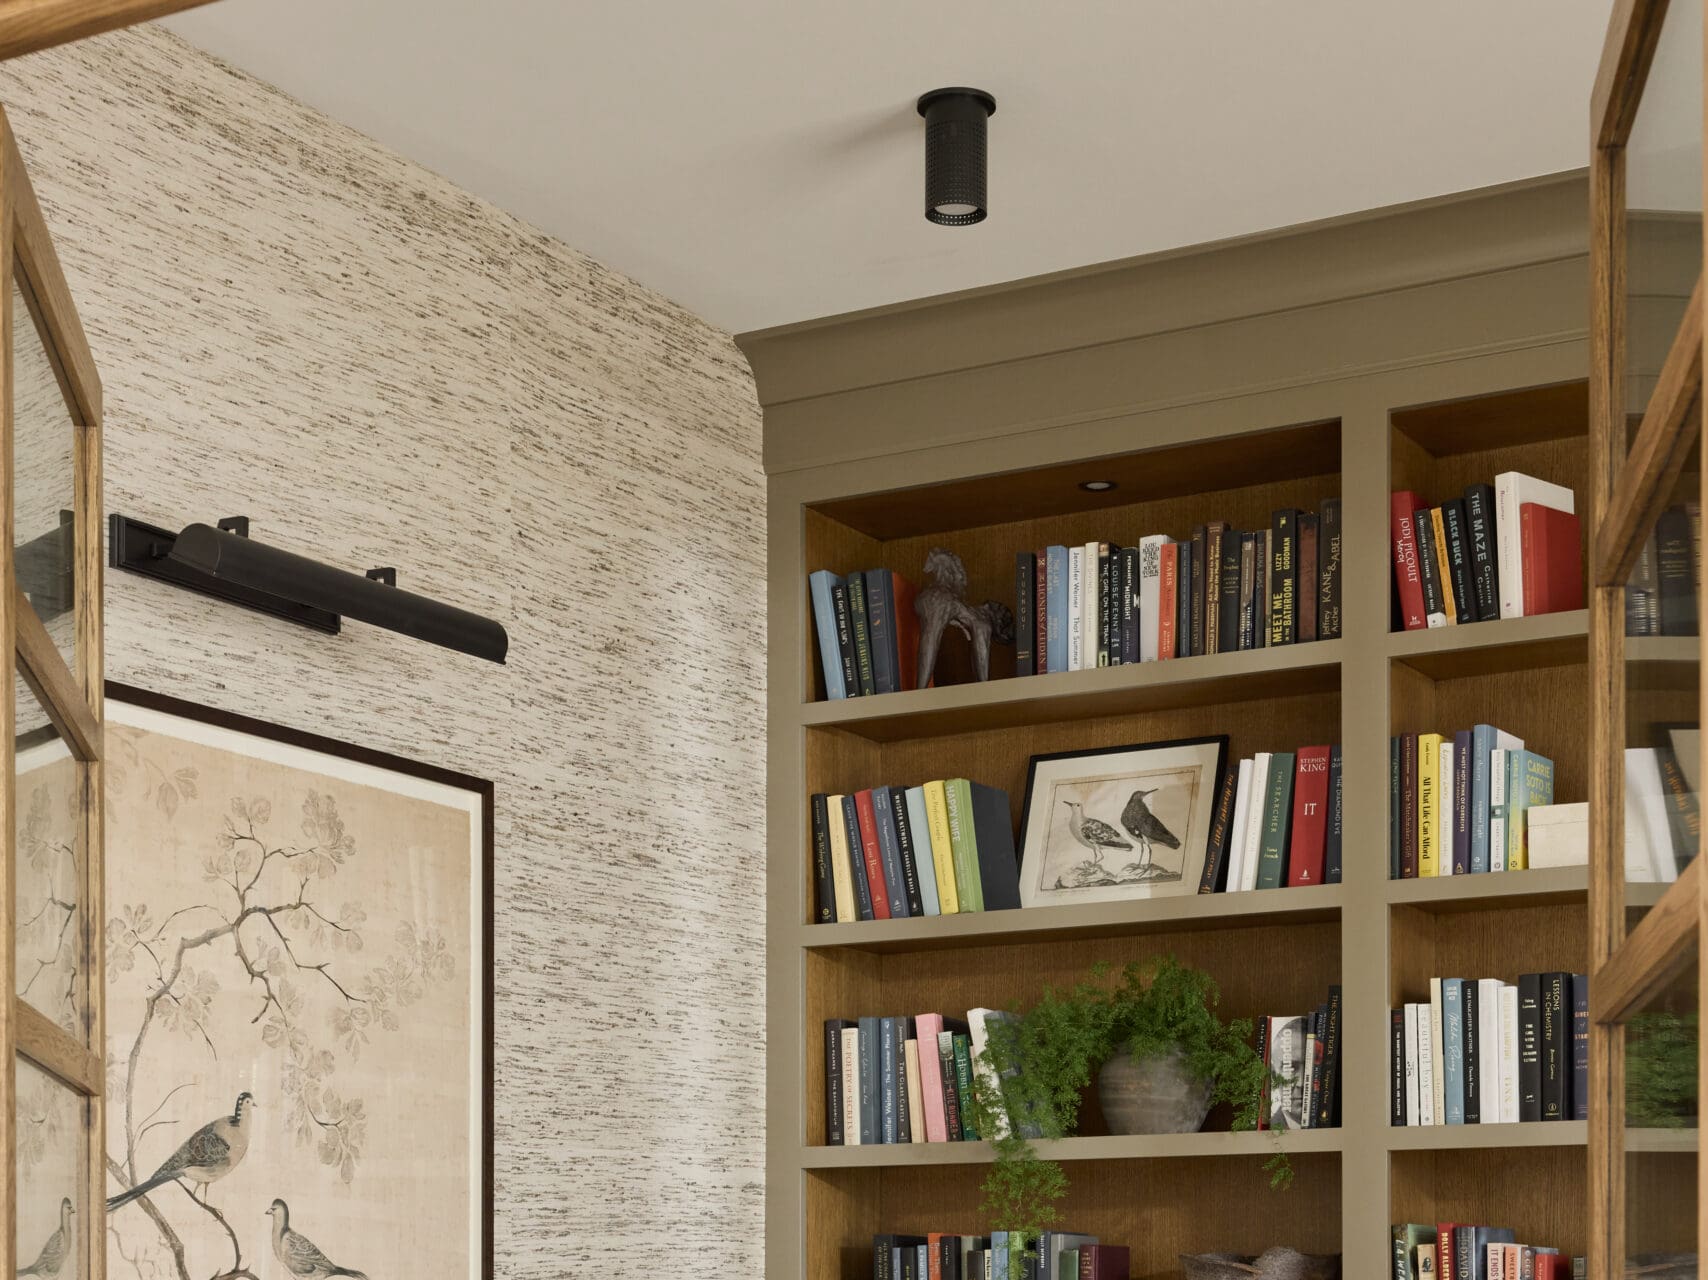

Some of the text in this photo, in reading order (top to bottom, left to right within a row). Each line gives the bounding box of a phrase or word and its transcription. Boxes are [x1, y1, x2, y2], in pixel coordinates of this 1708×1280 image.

[1448, 509, 1463, 566] BLACK BUCK
[1471, 493, 1487, 562] THE MAZE
[1399, 517, 1417, 583] JODI PICOULT
[1322, 571, 1331, 603] KANE
[1331, 533, 1340, 561] ABEL
[1273, 592, 1283, 642] MEET ME
[1283, 578, 1292, 626] BATHROOM
[1300, 763, 1326, 773] KING
[1528, 759, 1551, 778] CARRIE
[946, 785, 957, 818] HAPPY
[1270, 786, 1282, 833] SEARCHER
[1304, 803, 1317, 816] IT
[1423, 821, 1431, 837] Can
[1552, 979, 1560, 1011] LESSONS
[1447, 1012, 1461, 1042] Malibu
[1441, 1232, 1449, 1254] DOLLY
[1459, 1246, 1468, 1279] DAVID
